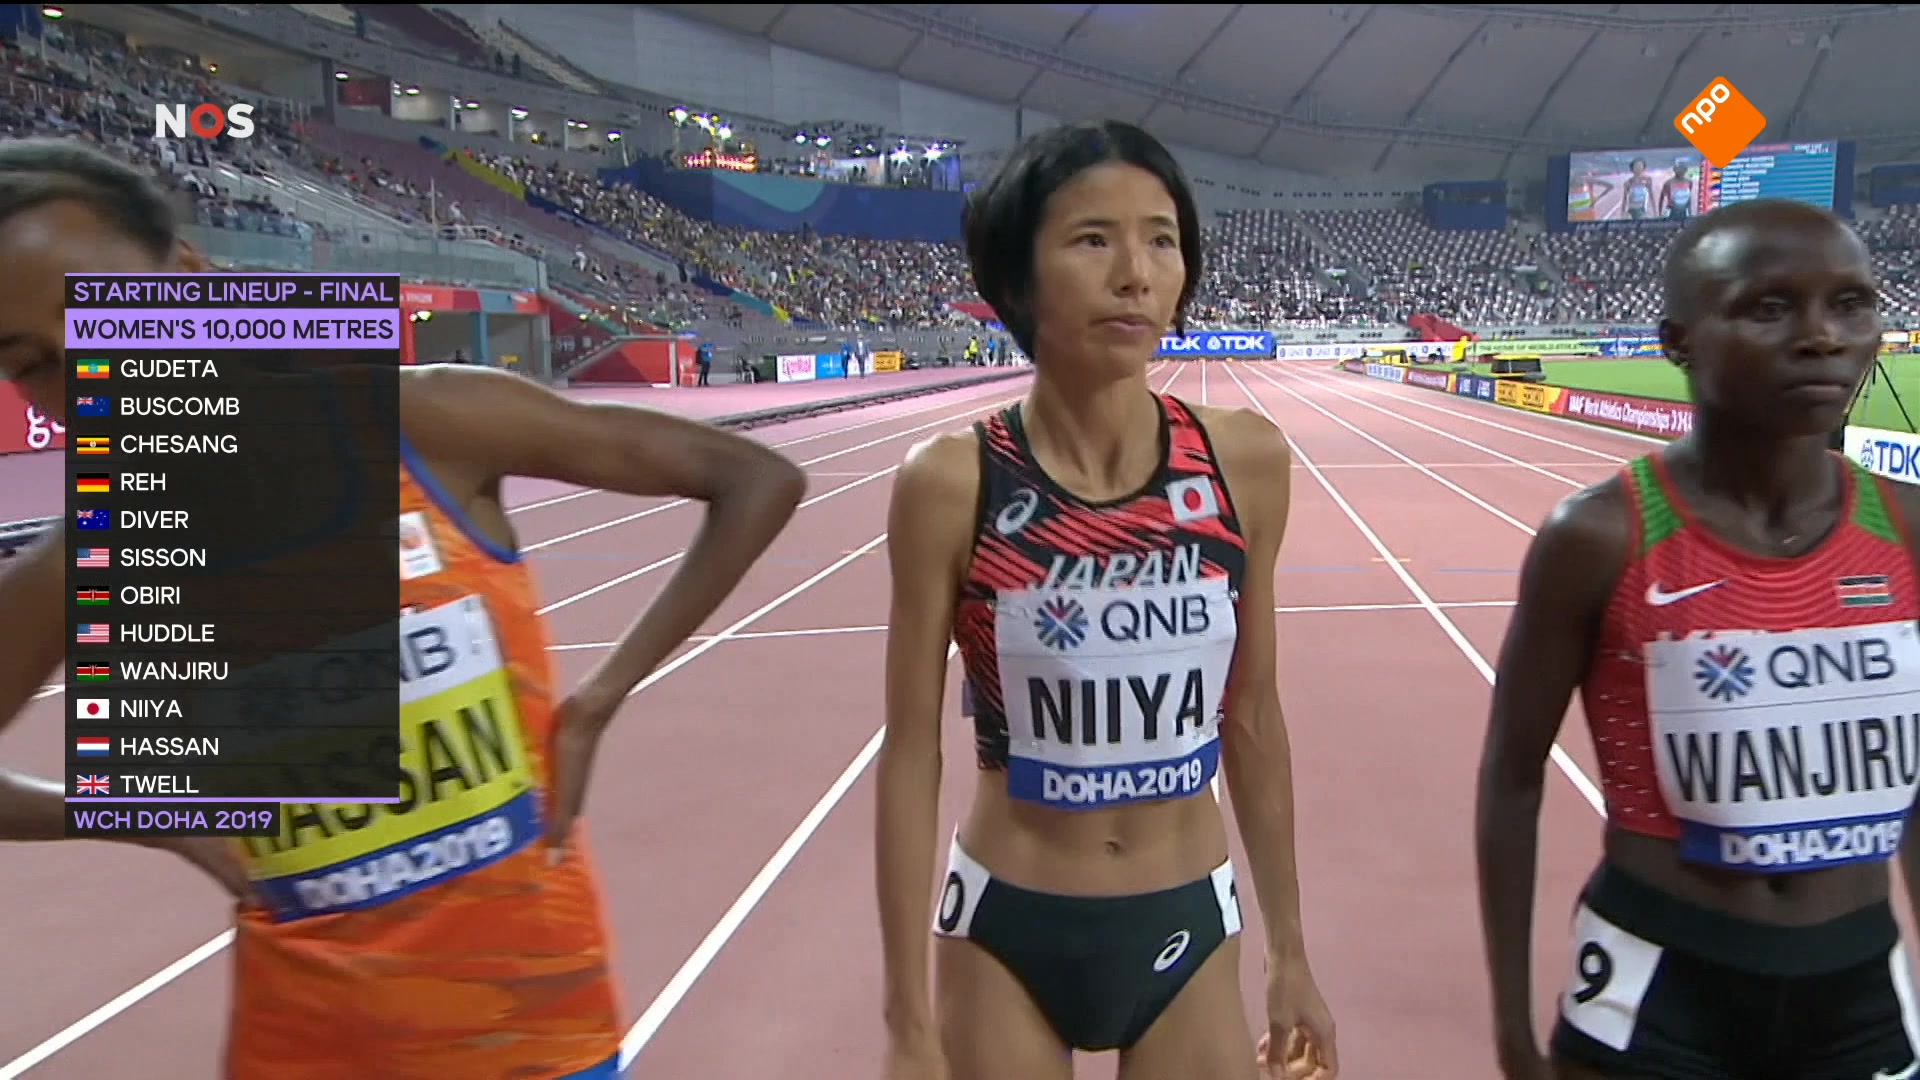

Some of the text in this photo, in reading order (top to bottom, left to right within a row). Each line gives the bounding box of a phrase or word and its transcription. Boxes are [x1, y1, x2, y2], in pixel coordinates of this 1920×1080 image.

[1220, 335, 1265, 350] TDK
[1874, 440, 1920, 479] TDK
[1030, 544, 1201, 592] JAPAN
[1101, 594, 1211, 643] QNB
[1768, 638, 1896, 689] QNB
[1027, 668, 1205, 746] NIIYA
[1042, 758, 1203, 804] DOHA2019
[1665, 713, 1920, 804] WANJIRU
[1720, 818, 1902, 867] DOHA2019
[1573, 941, 1612, 1004] 9
